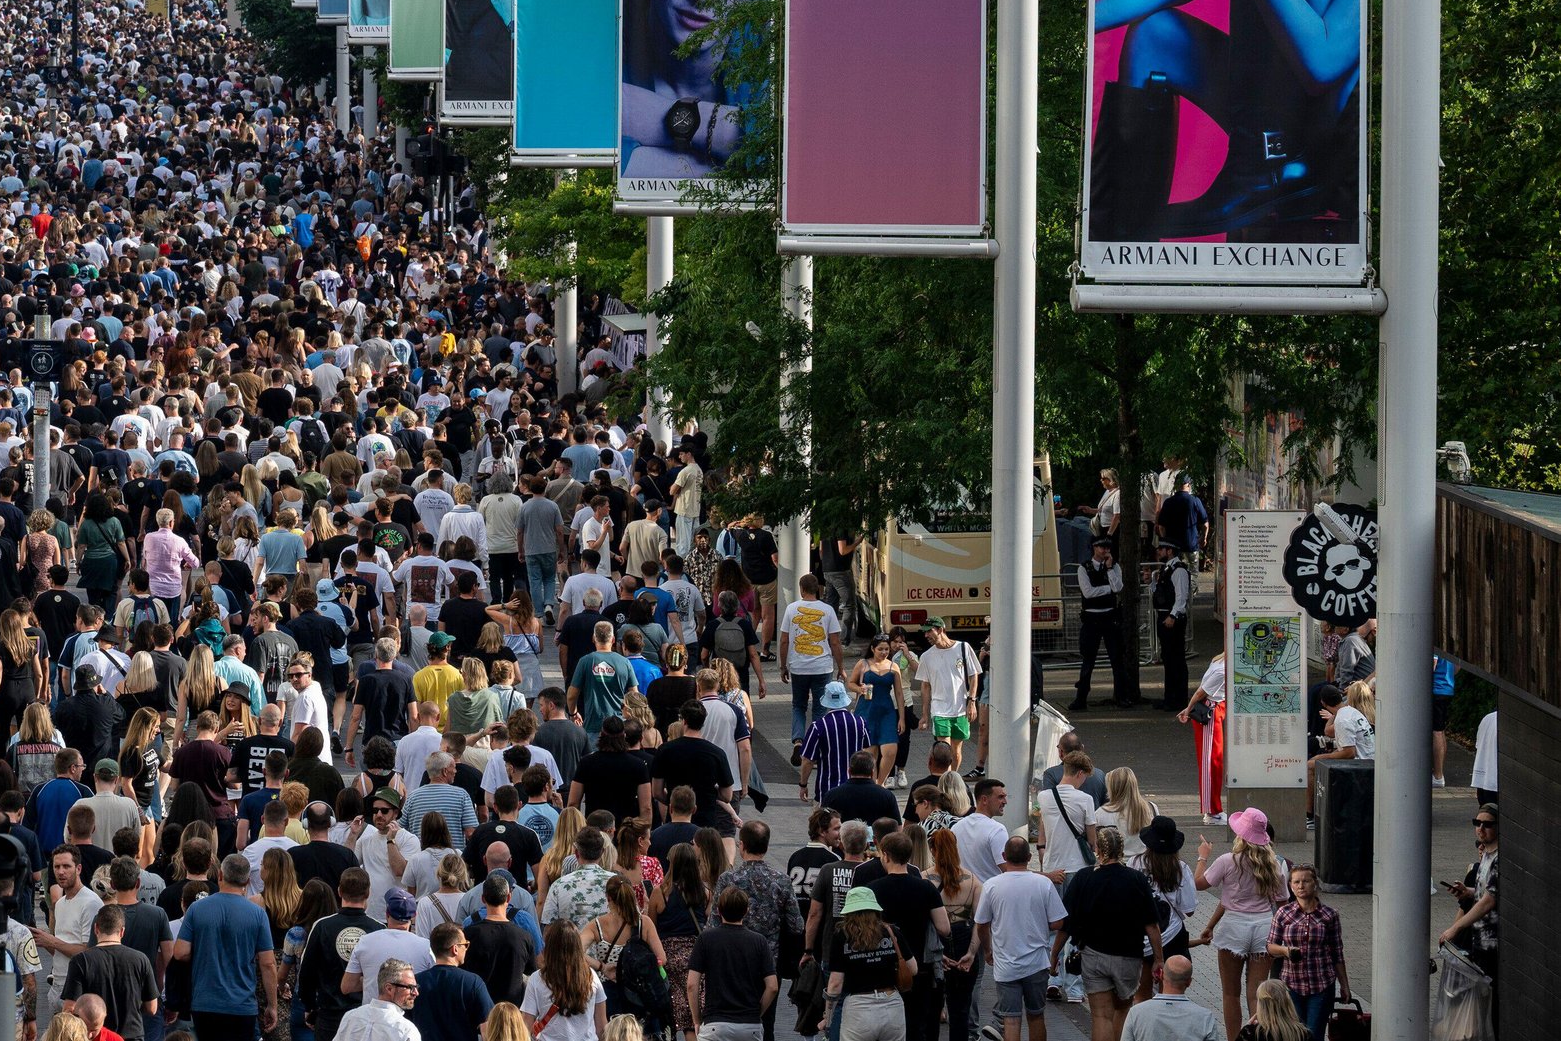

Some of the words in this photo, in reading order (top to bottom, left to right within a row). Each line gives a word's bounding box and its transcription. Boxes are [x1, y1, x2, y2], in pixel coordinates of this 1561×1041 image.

[450, 101, 487, 110] ARMANI
[627, 179, 678, 191] ARMAN
[1101, 245, 1198, 266] ARMANI
[1213, 245, 1347, 267] EXCHANGE
[907, 588, 923, 599] ICE
[926, 588, 963, 599] CREAM
[1320, 575, 1378, 617] COFFE
[248, 746, 267, 791] BEAT
[833, 867, 853, 878] LIAM
[849, 952, 875, 960] WEMBLEY
[876, 948, 896, 956] STADIU
